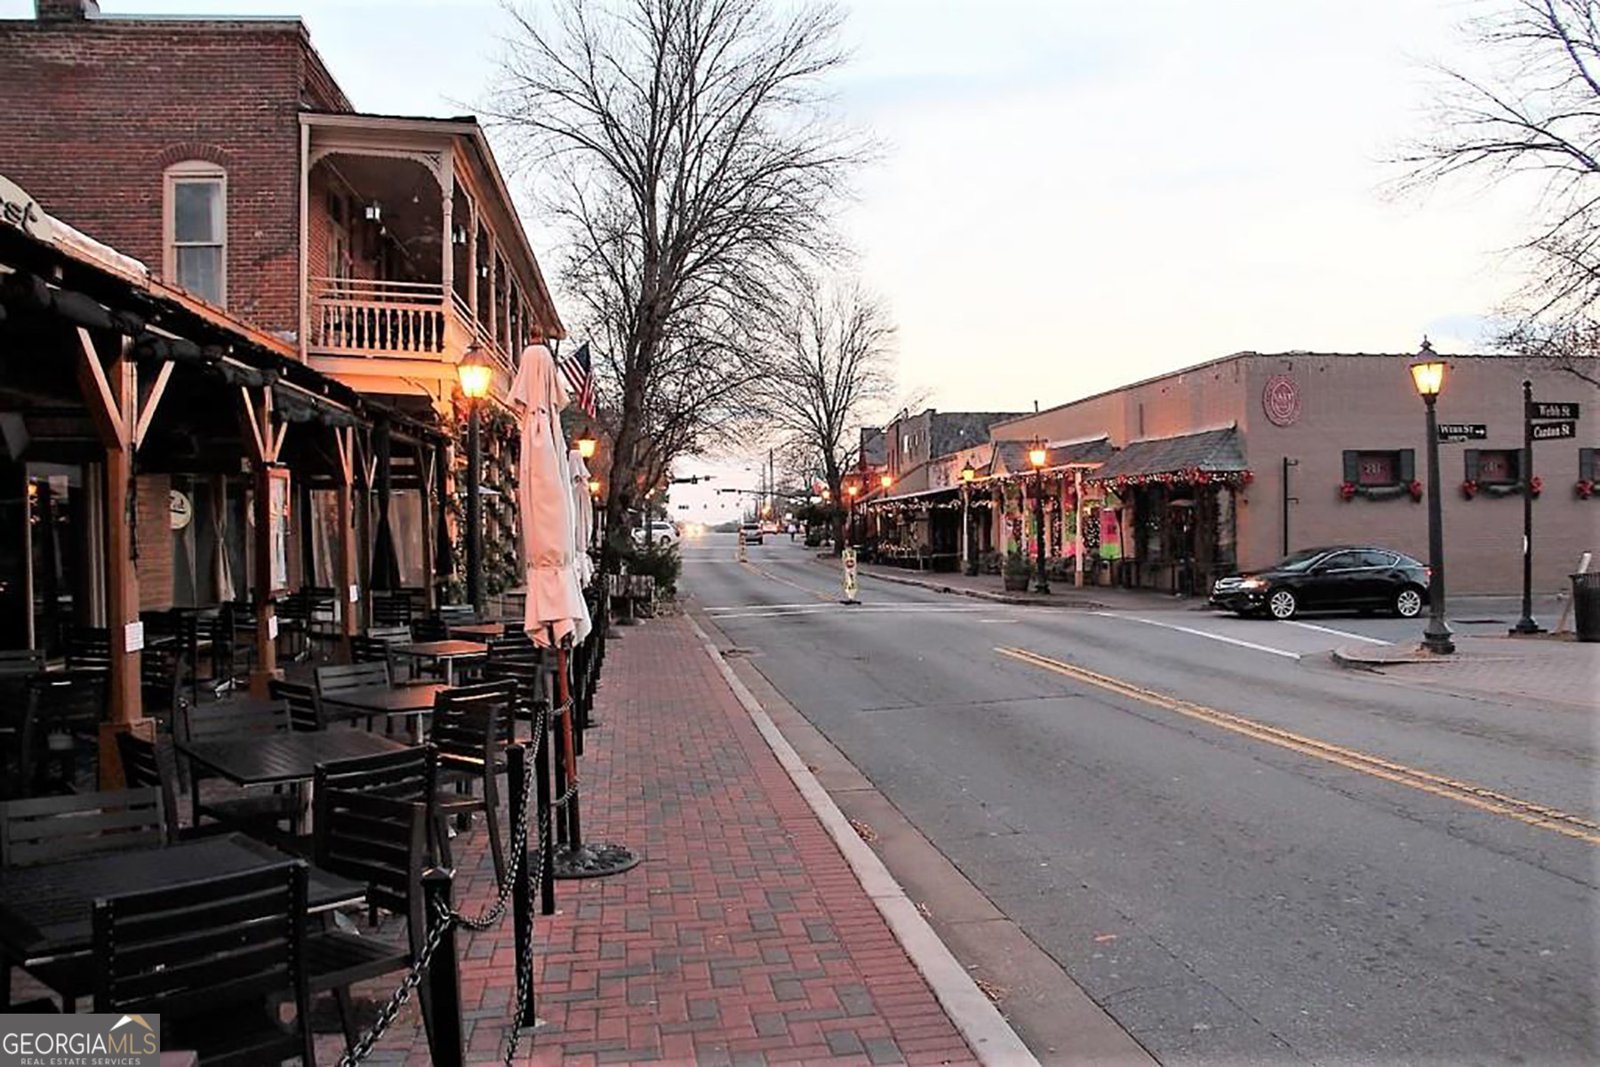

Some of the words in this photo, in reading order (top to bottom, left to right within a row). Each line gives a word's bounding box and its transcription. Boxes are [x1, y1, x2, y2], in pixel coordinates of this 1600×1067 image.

[1538, 404, 1560, 417] Webb
[1561, 405, 1571, 417] St
[1534, 425, 1560, 438] Canton
[1561, 424, 1570, 436] St
